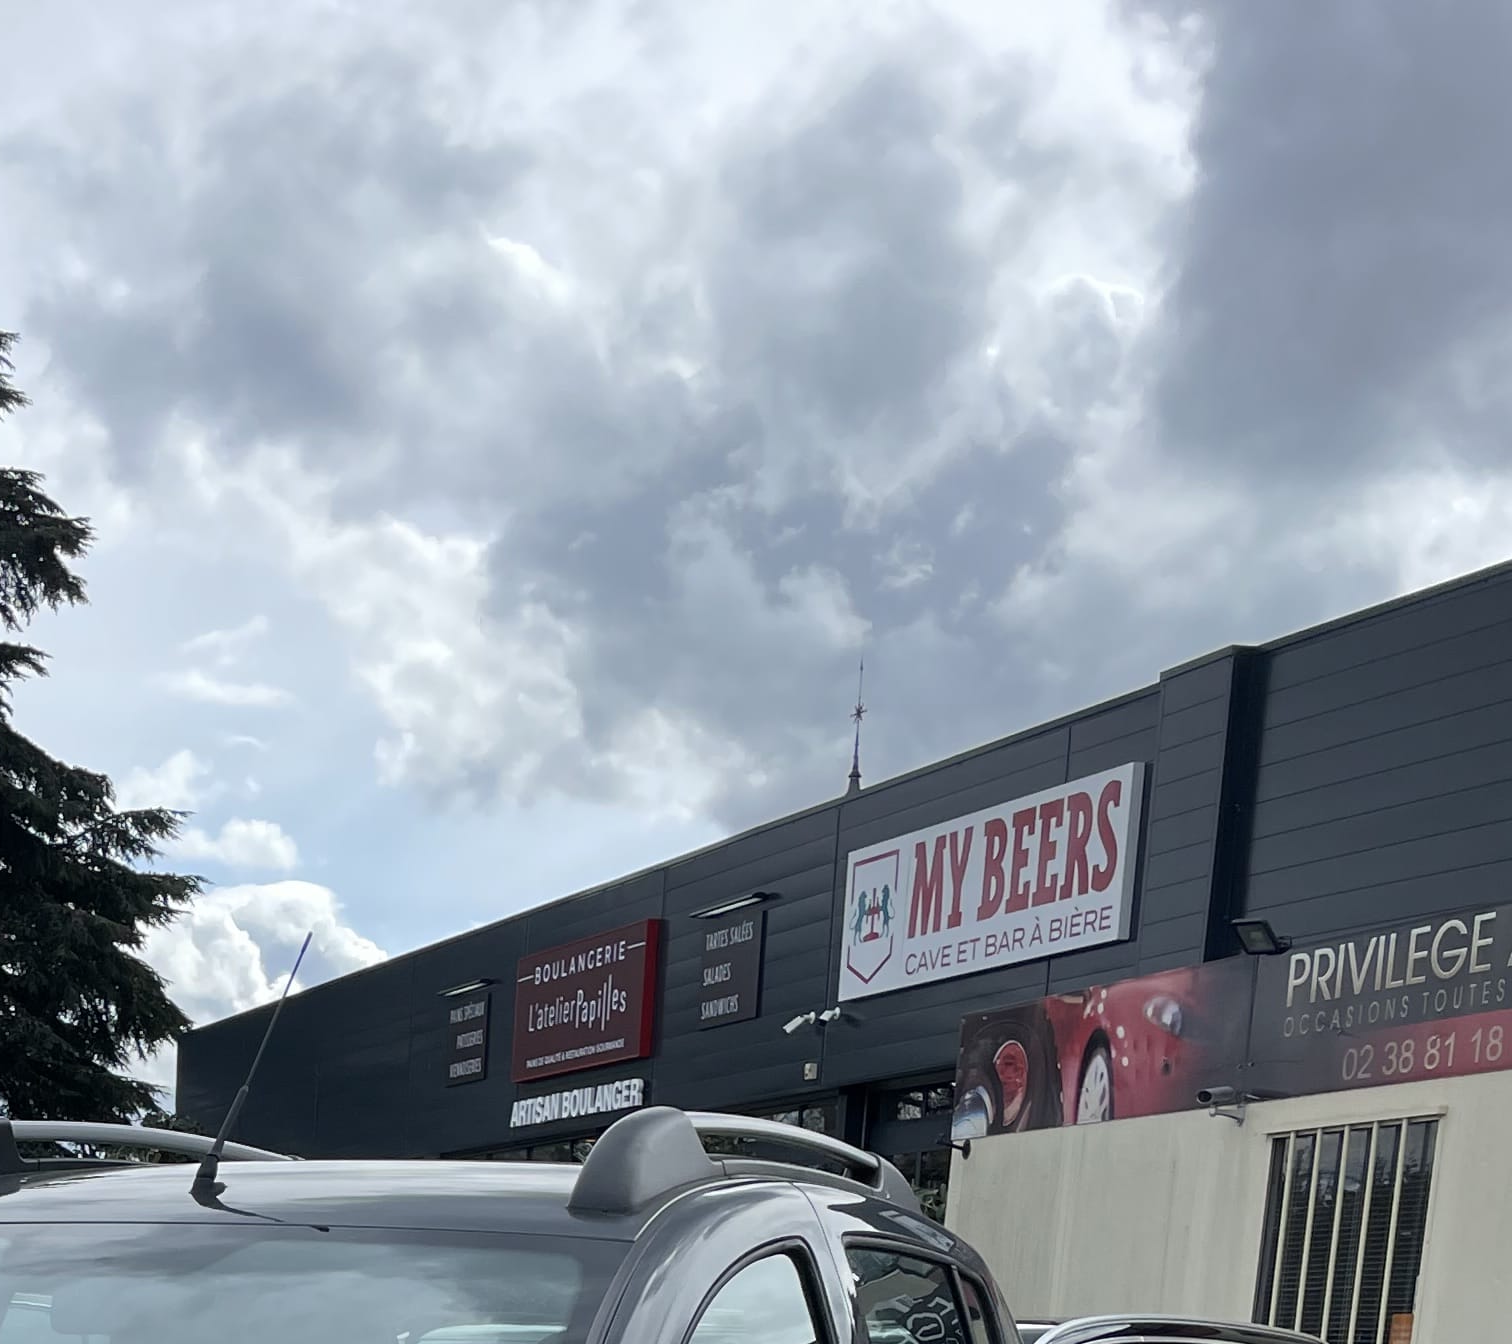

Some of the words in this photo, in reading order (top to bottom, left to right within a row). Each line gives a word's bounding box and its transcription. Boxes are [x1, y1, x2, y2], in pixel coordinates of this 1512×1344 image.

[907, 826, 974, 939] MY
[976, 780, 1122, 922] BEERS
[534, 940, 626, 985] BOULANGERIE
[905, 944, 952, 975] CAVE
[956, 937, 981, 963] ET
[984, 927, 1026, 957] BAR
[1029, 916, 1043, 948] À
[1048, 906, 1113, 943] BIÈRE
[1286, 911, 1497, 1008] PRIVILEGE
[1283, 996, 1409, 1037] OCCASIONS
[1422, 978, 1506, 1014] TOUTES
[1342, 1044, 1374, 1081] 02
[1382, 1039, 1415, 1075] 38
[1423, 1031, 1456, 1070] 81
[1470, 1025, 1504, 1063] 18
[510, 1092, 560, 1128] ARTISAN
[561, 1078, 644, 1119] BOULANGER
